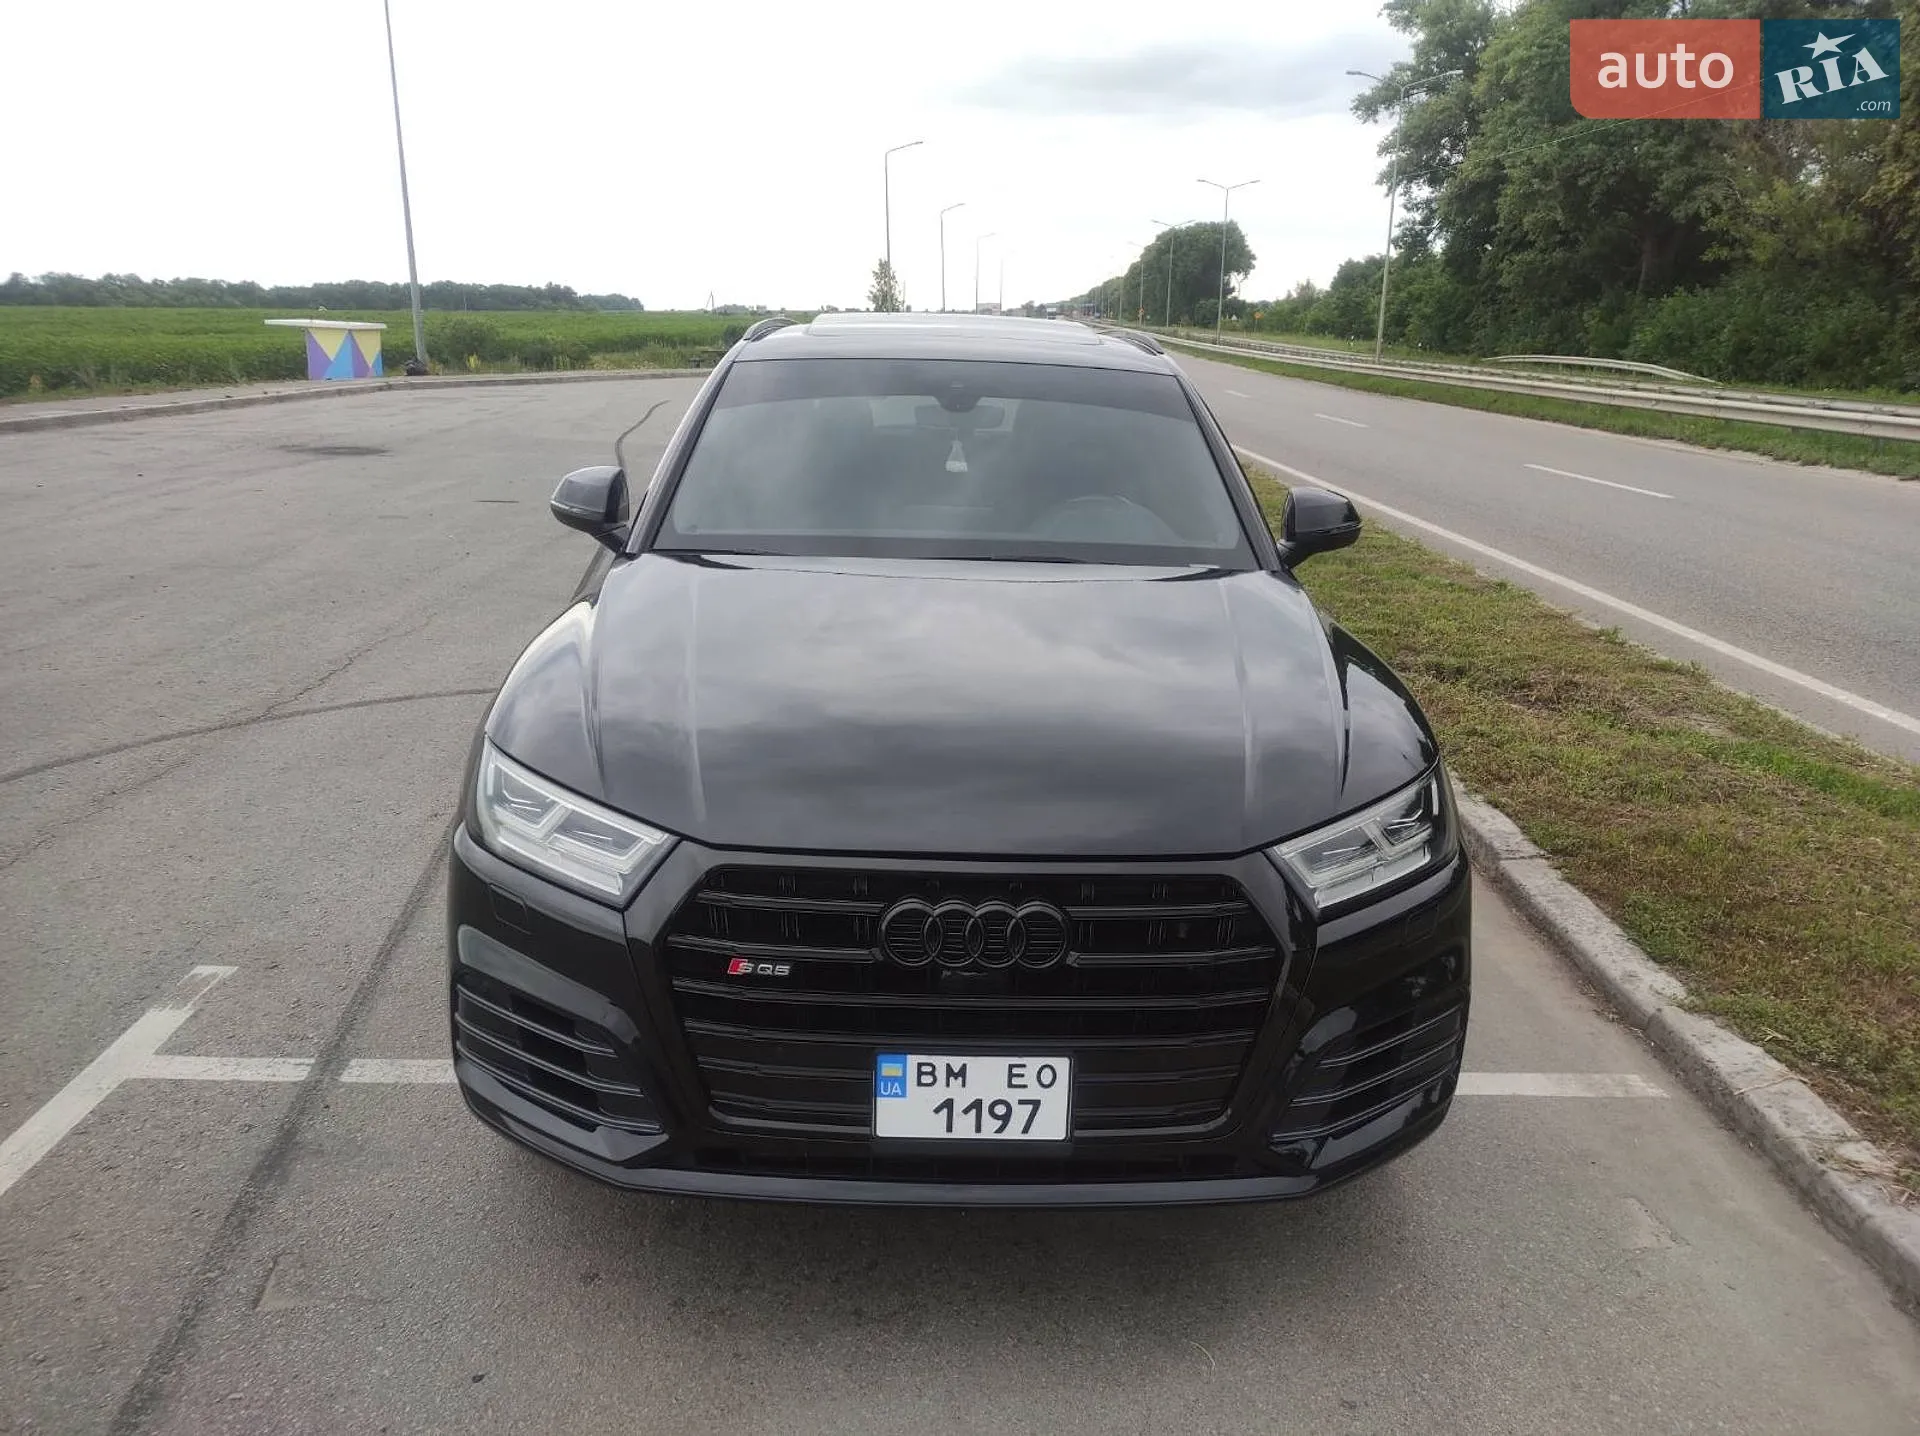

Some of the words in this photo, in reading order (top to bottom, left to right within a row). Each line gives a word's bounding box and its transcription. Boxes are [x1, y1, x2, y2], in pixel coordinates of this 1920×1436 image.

[880, 1081, 902, 1096] UA
[916, 1062, 968, 1089] BM
[1007, 1063, 1057, 1089] EO
[932, 1098, 1042, 1135] 1197
